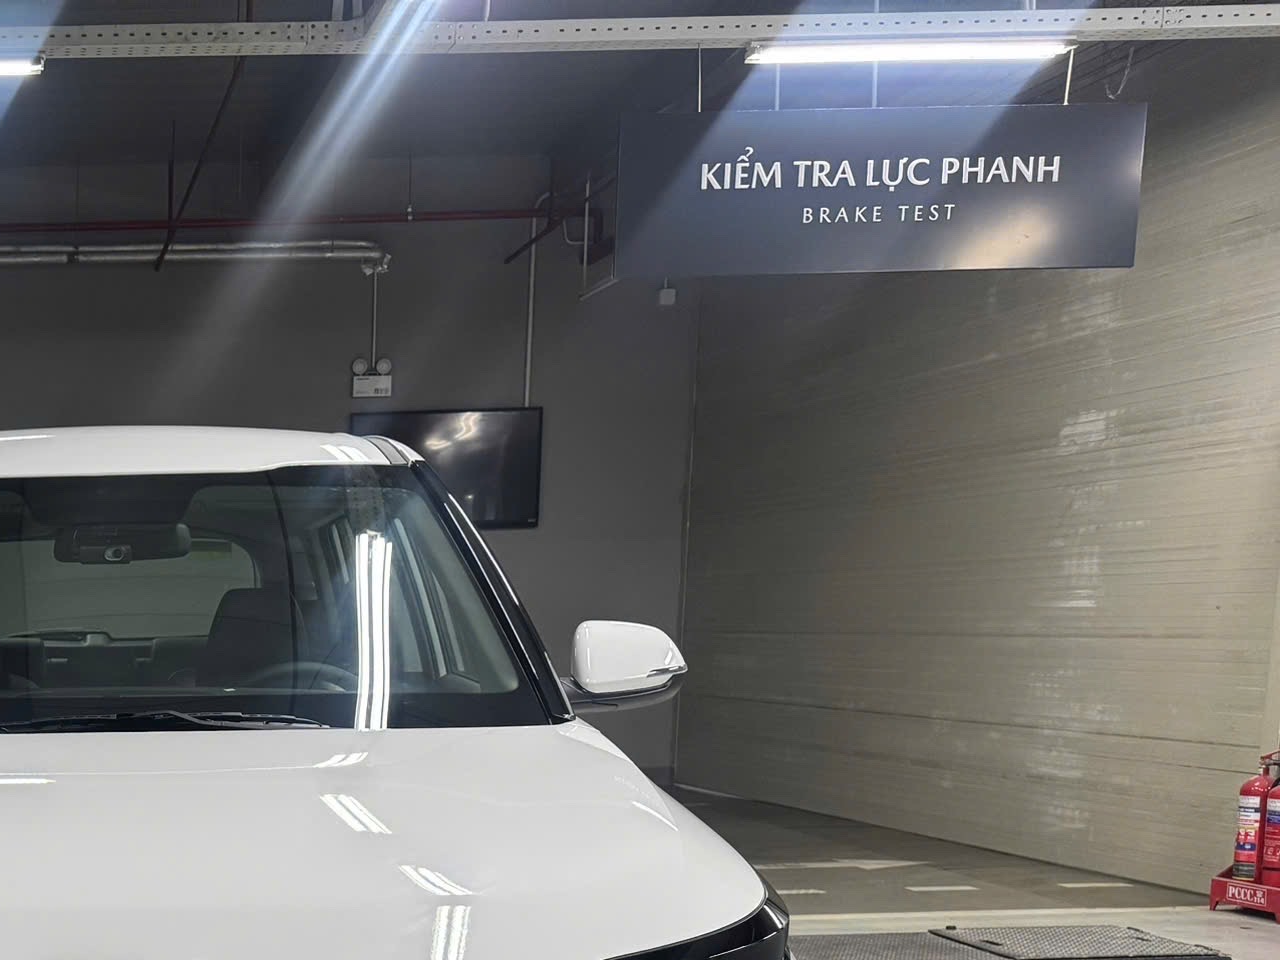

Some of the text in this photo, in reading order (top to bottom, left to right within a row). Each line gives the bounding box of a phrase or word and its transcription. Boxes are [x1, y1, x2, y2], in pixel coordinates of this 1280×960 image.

[700, 147, 1061, 192] KIỂM TRA LỰC PHANH
[802, 204, 956, 224] BRAKE TEST
[1228, 885, 1254, 901] PCCC
